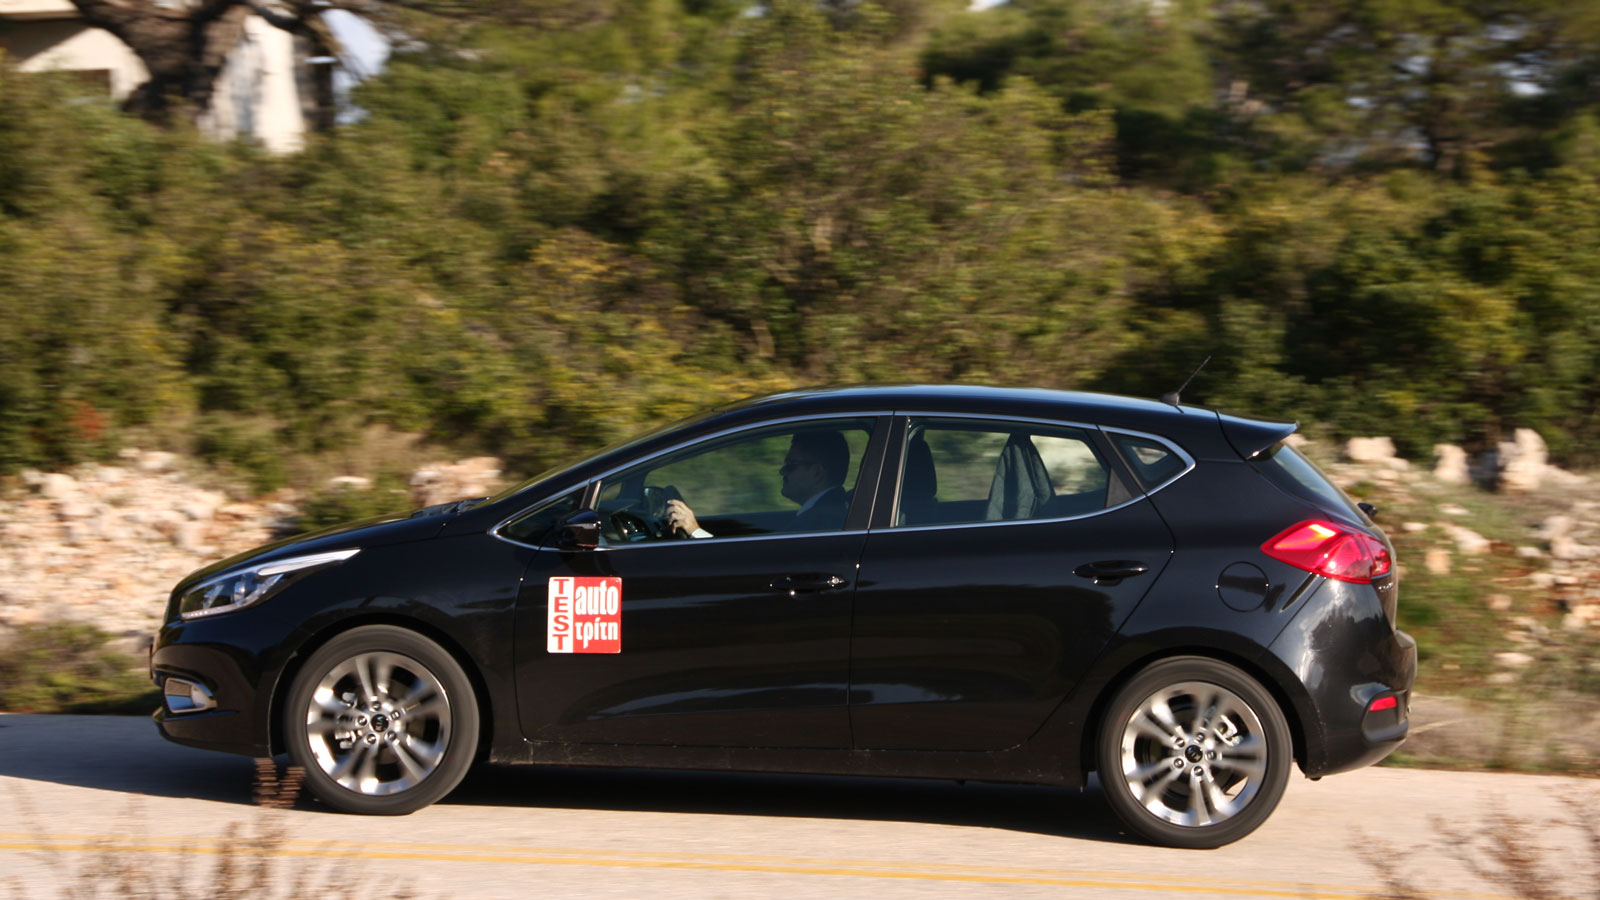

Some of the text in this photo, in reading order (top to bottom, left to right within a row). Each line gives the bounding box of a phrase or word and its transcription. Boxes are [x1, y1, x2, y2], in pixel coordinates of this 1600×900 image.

[552, 579, 570, 650] TEST
[575, 580, 618, 615] auto
[575, 617, 618, 649] τρίτη
